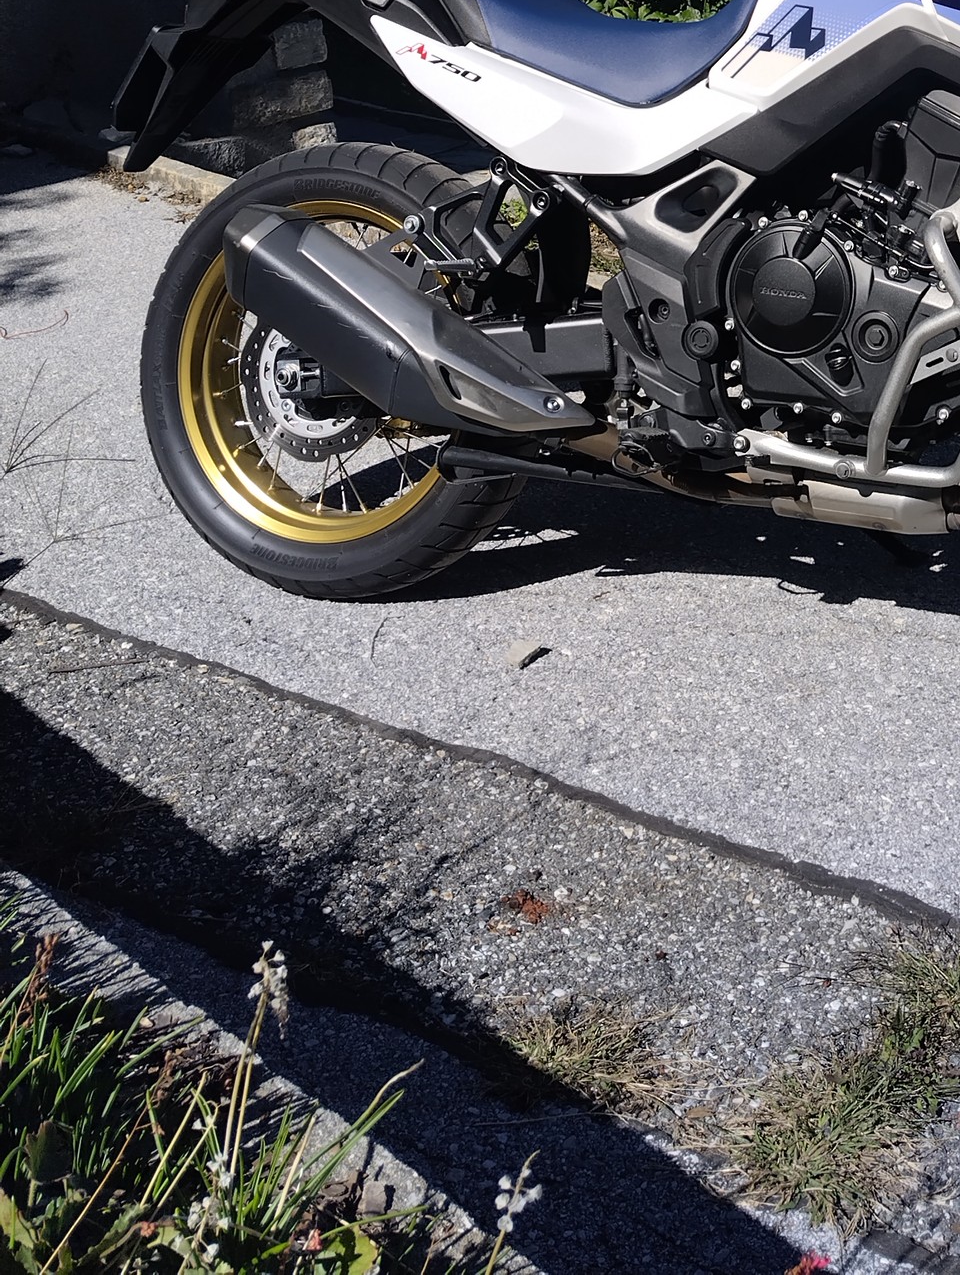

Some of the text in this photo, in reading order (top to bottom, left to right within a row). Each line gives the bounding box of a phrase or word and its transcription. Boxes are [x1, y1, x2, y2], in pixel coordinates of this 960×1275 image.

[428, 54, 482, 82] 750
[293, 178, 381, 200] BRIDGESTONE
[759, 286, 807, 300] HONDA
